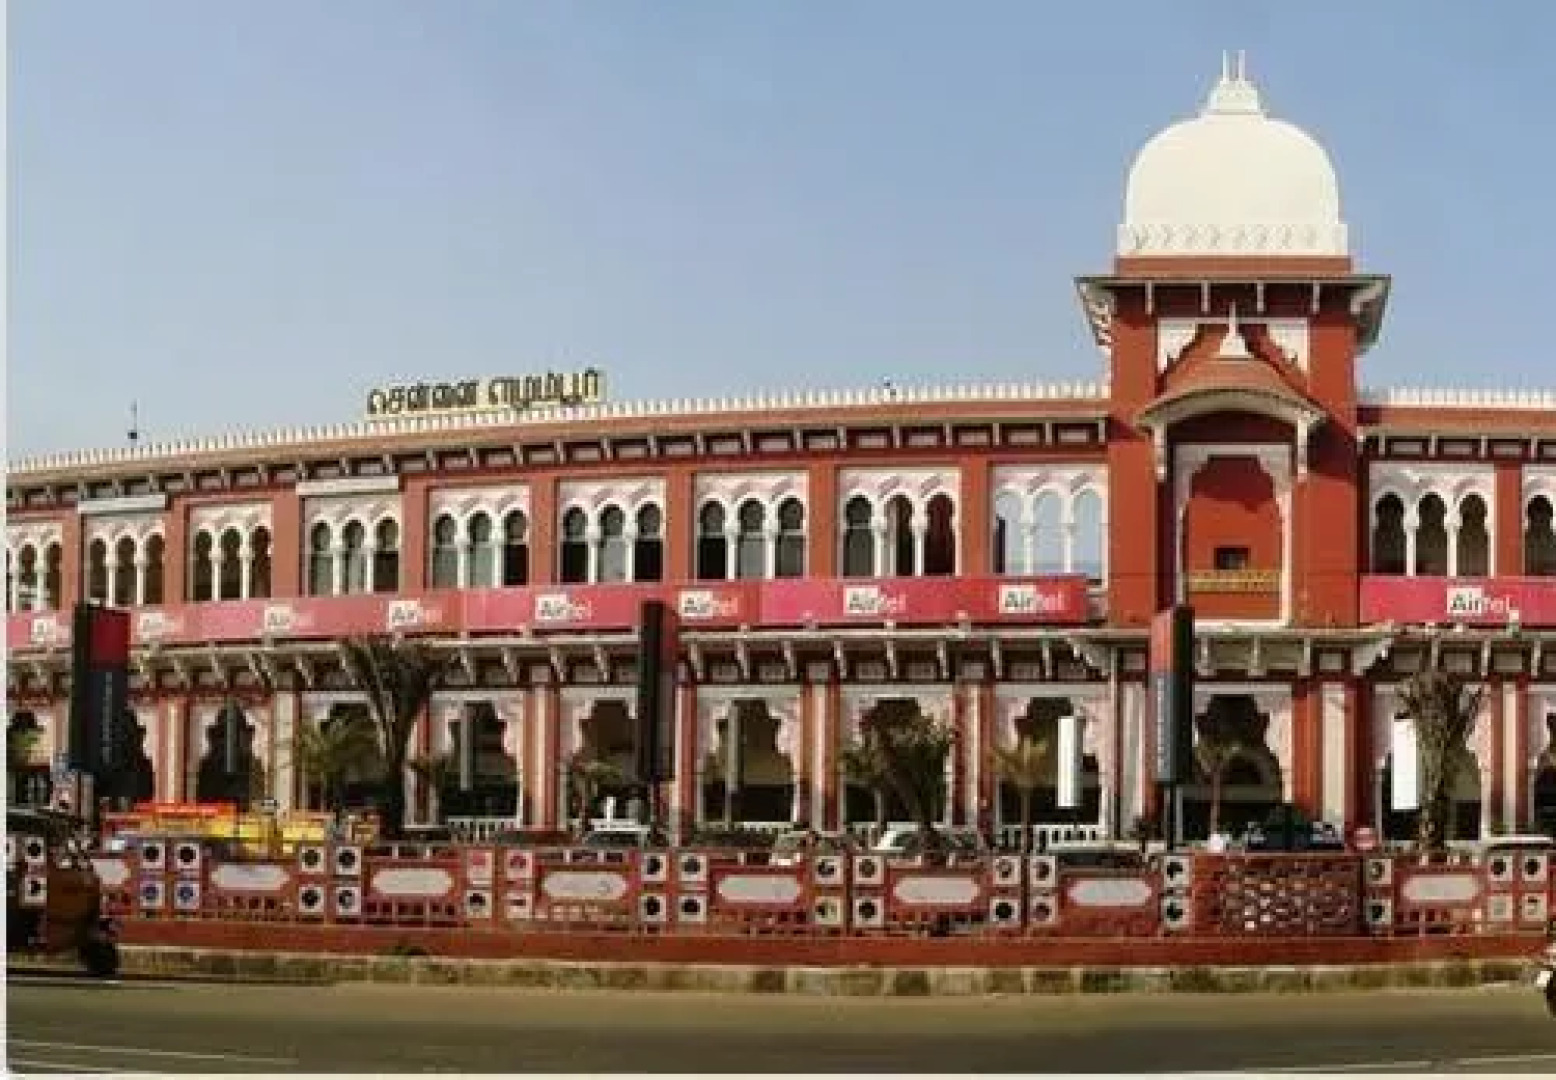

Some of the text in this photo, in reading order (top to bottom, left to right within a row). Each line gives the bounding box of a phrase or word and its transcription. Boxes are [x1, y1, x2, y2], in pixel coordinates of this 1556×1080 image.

[848, 592, 907, 613] Airtel
[1004, 589, 1065, 611] Airtel
[1450, 591, 1513, 613] Airtel
